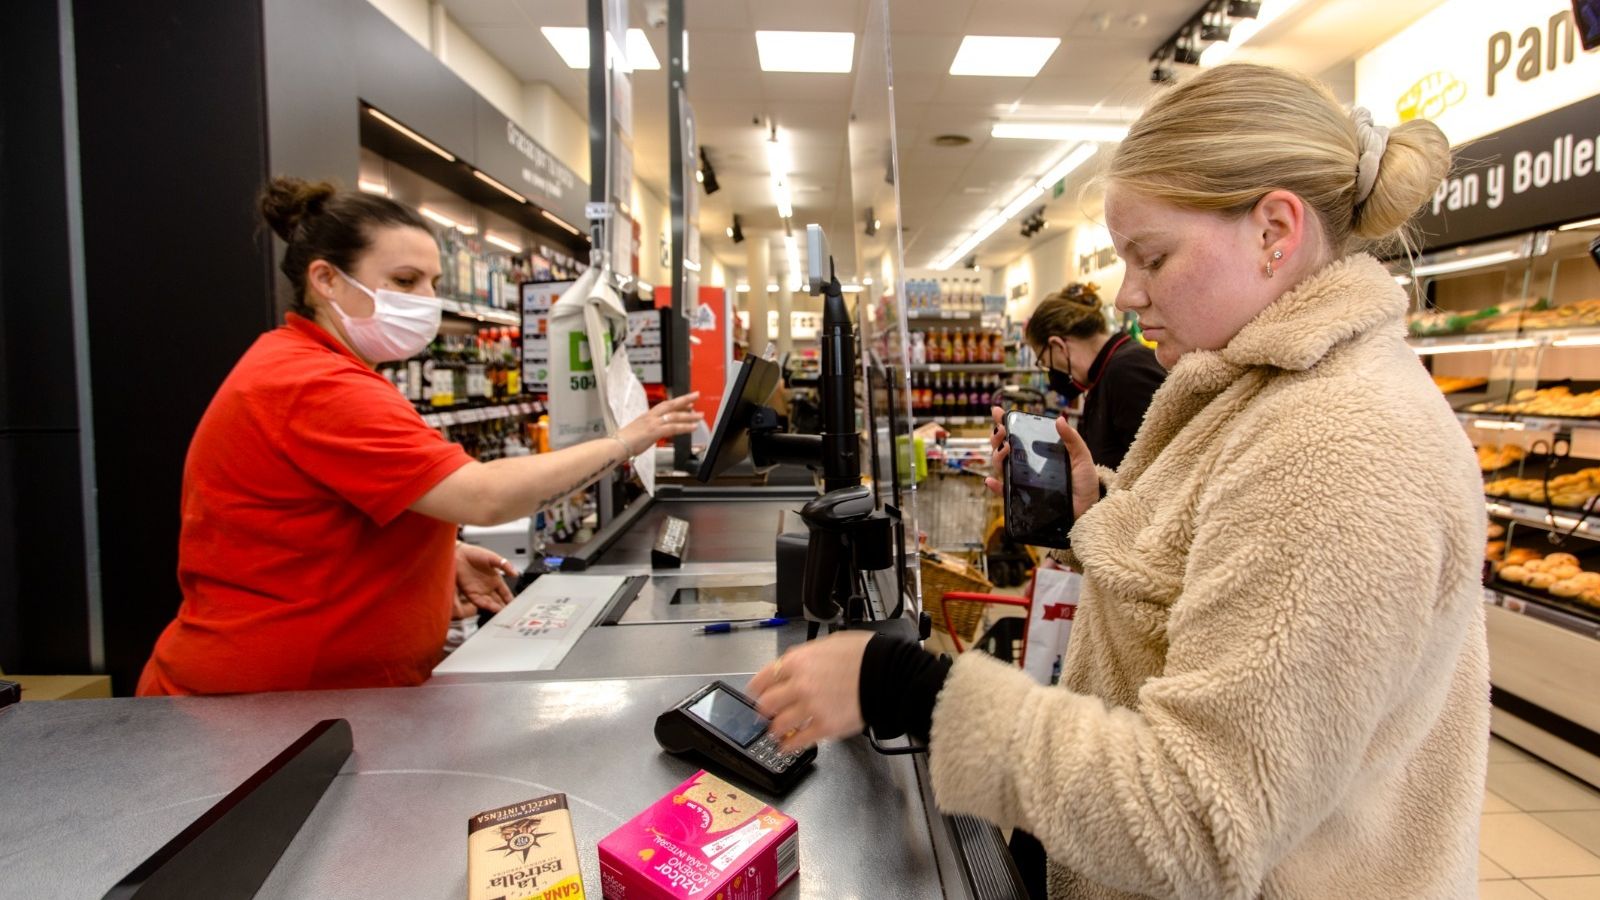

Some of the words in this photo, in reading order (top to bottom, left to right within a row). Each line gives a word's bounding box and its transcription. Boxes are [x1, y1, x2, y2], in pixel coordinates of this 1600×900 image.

[1486, 10, 1575, 97] Pan
[1431, 173, 1479, 216] Pan
[1486, 164, 1505, 210] y
[477, 807, 518, 823] INTENSA
[519, 797, 557, 810] MEZCLA
[653, 835, 688, 859] INTEGRAL
[488, 859, 563, 888] Estrella
[517, 876, 538, 889] La
[654, 863, 703, 897] Azúcar
[667, 857, 712, 889] MORENO
[707, 869, 720, 880] DE
[543, 881, 580, 900] GANA
